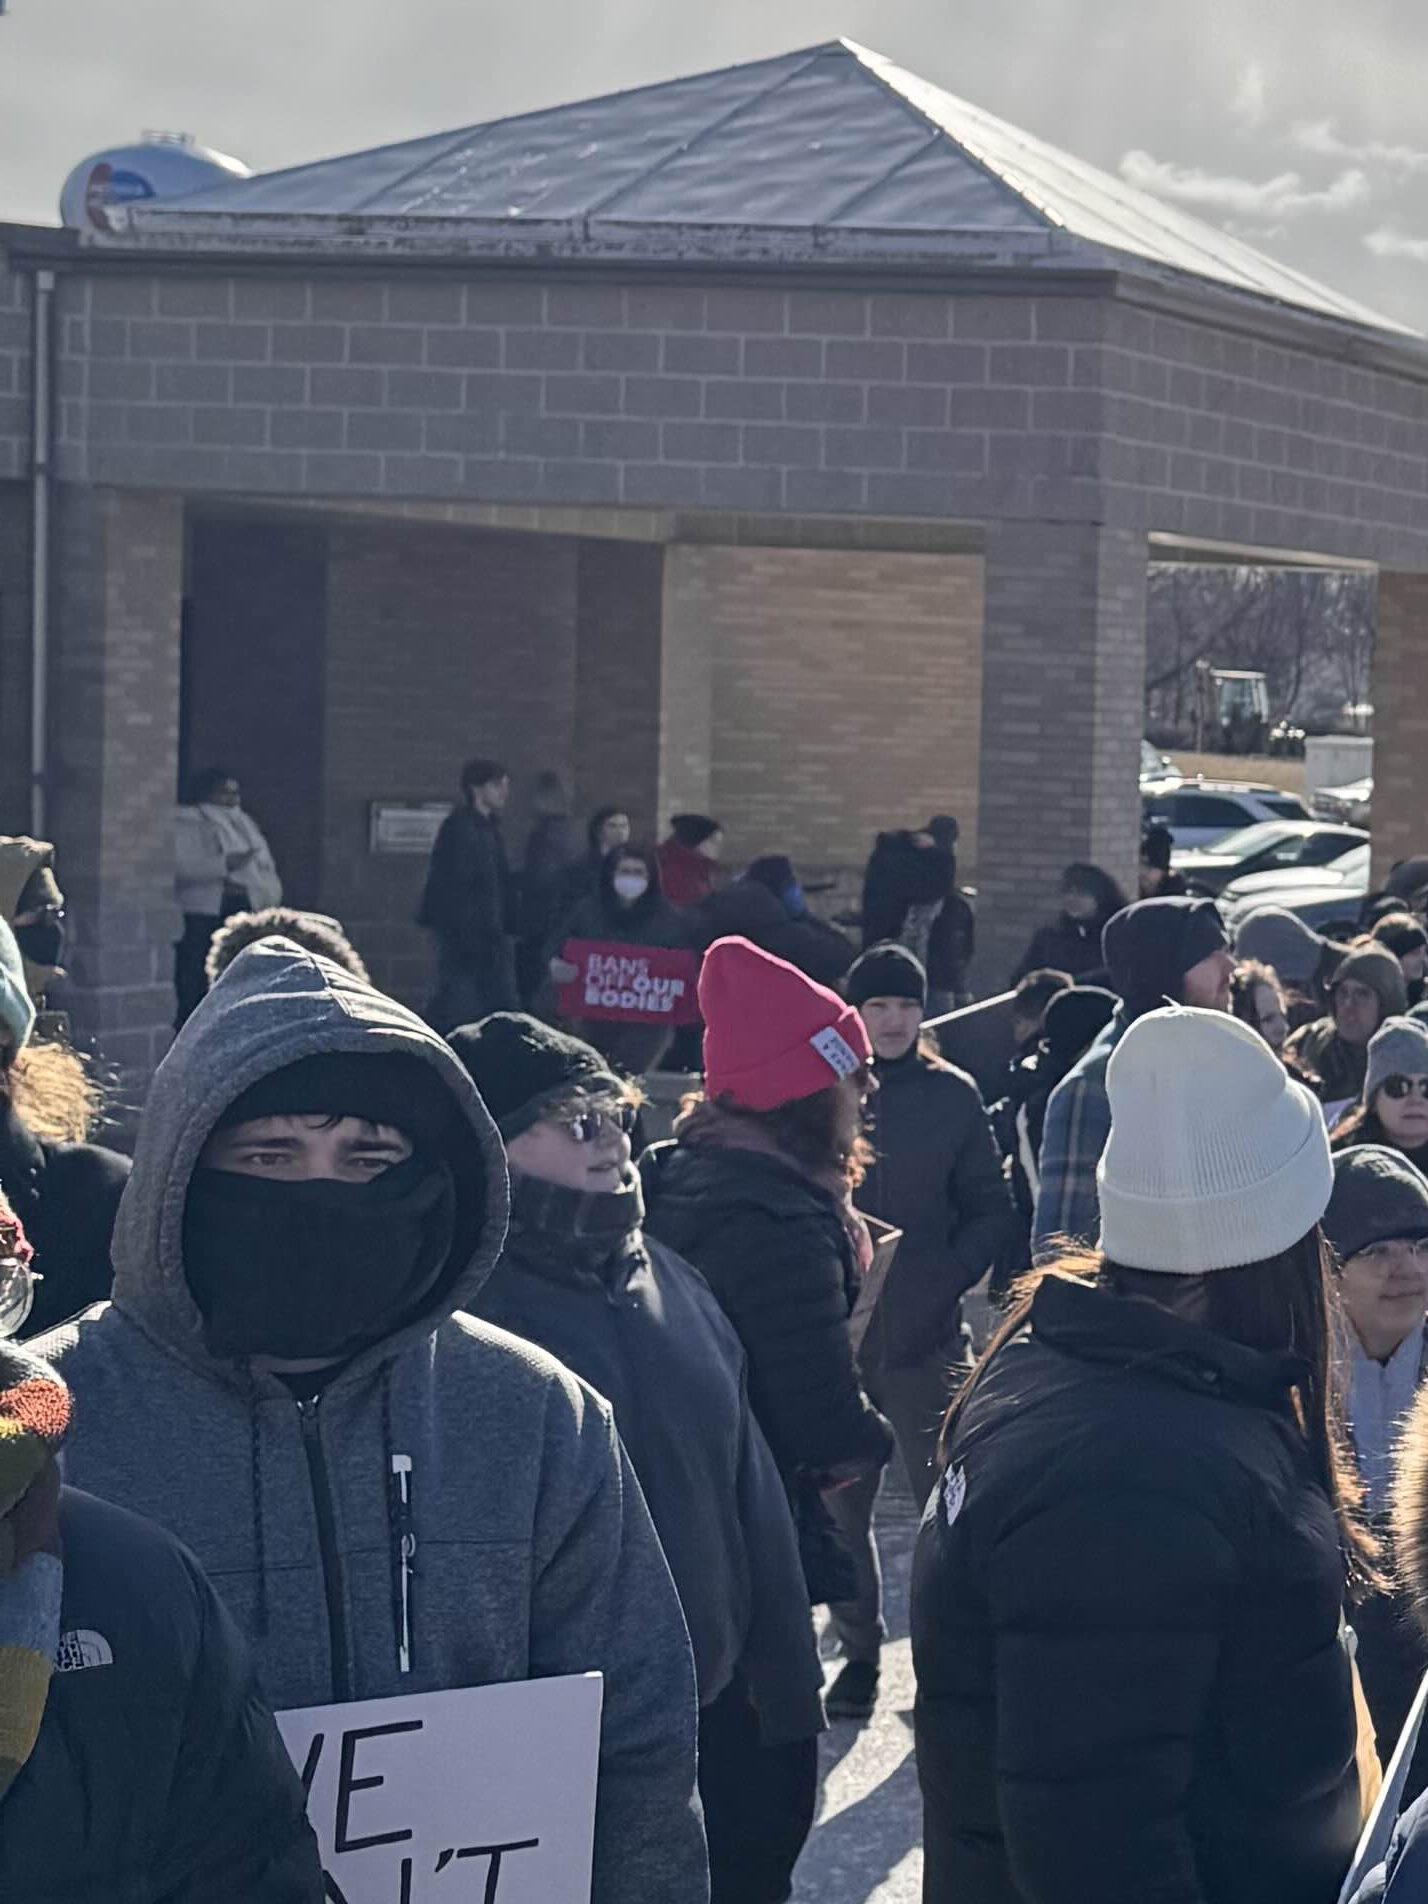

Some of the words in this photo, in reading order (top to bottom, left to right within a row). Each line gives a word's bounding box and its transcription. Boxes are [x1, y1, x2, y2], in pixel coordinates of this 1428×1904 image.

[587, 953, 649, 975] BANS
[633, 975, 684, 997] OUR
[584, 986, 673, 1012] BODIES
